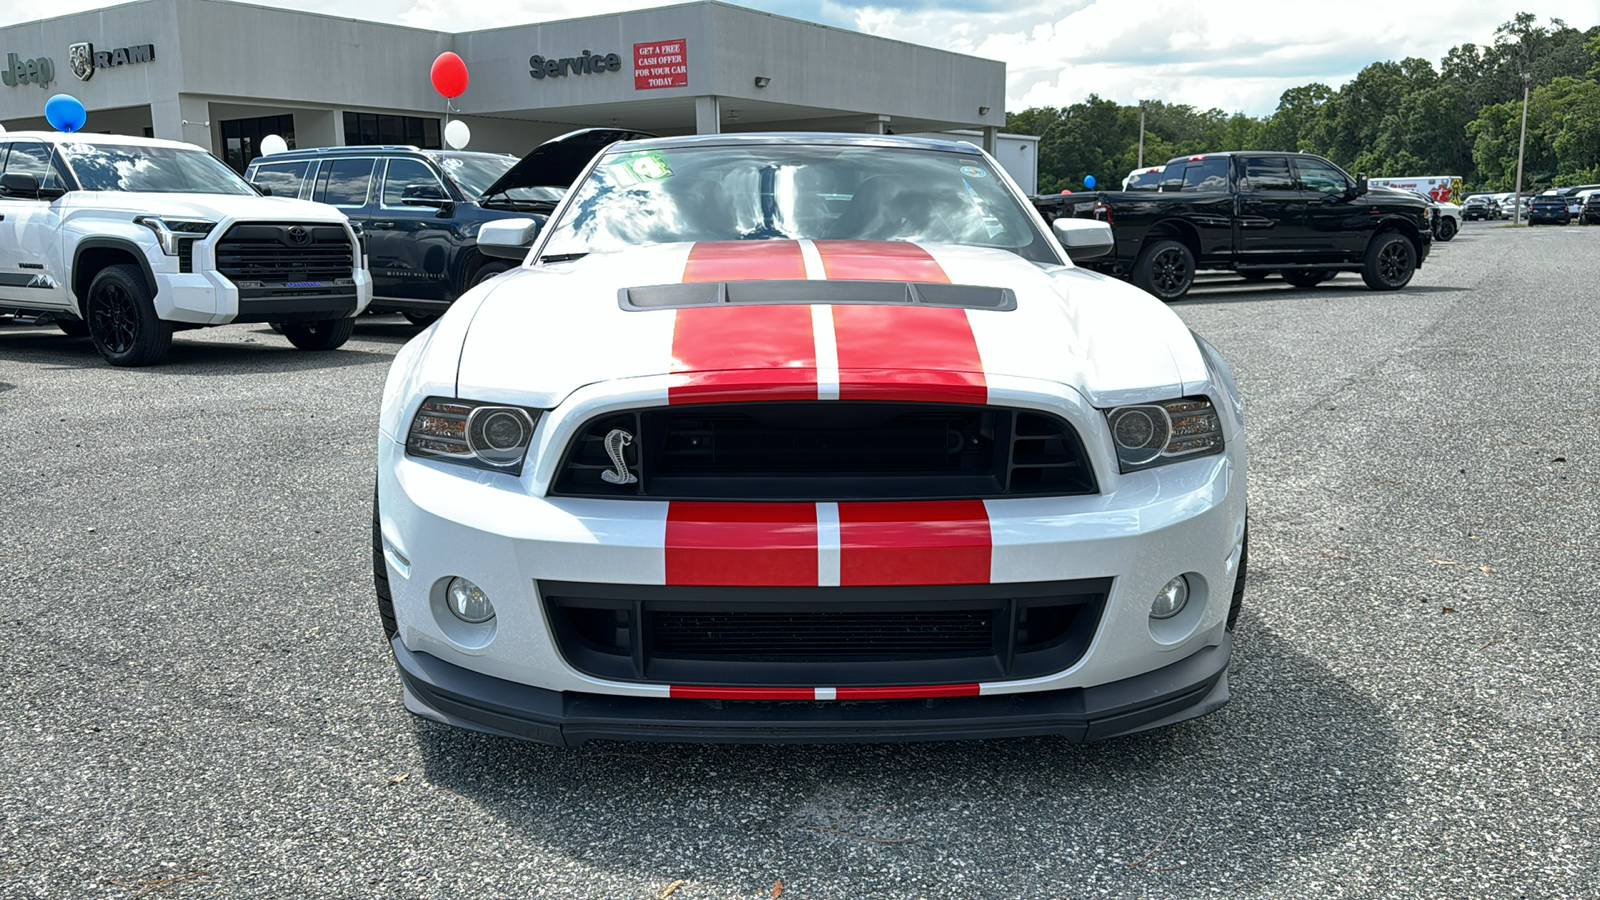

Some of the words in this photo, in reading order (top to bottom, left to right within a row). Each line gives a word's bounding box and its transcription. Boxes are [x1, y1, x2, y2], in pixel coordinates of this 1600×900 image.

[639, 46, 654, 55] GET
[654, 45, 661, 54] A
[661, 43, 681, 54] FREE
[94, 44, 155, 68] RAM
[638, 57, 657, 67] CASH
[658, 54, 682, 65] OFFER
[1, 52, 55, 89] Jeep
[529, 49, 621, 79] Service
[635, 68, 650, 77] FOR
[650, 66, 670, 76] YOUR
[671, 65, 687, 74] CAR
[648, 77, 673, 87] TODAY
